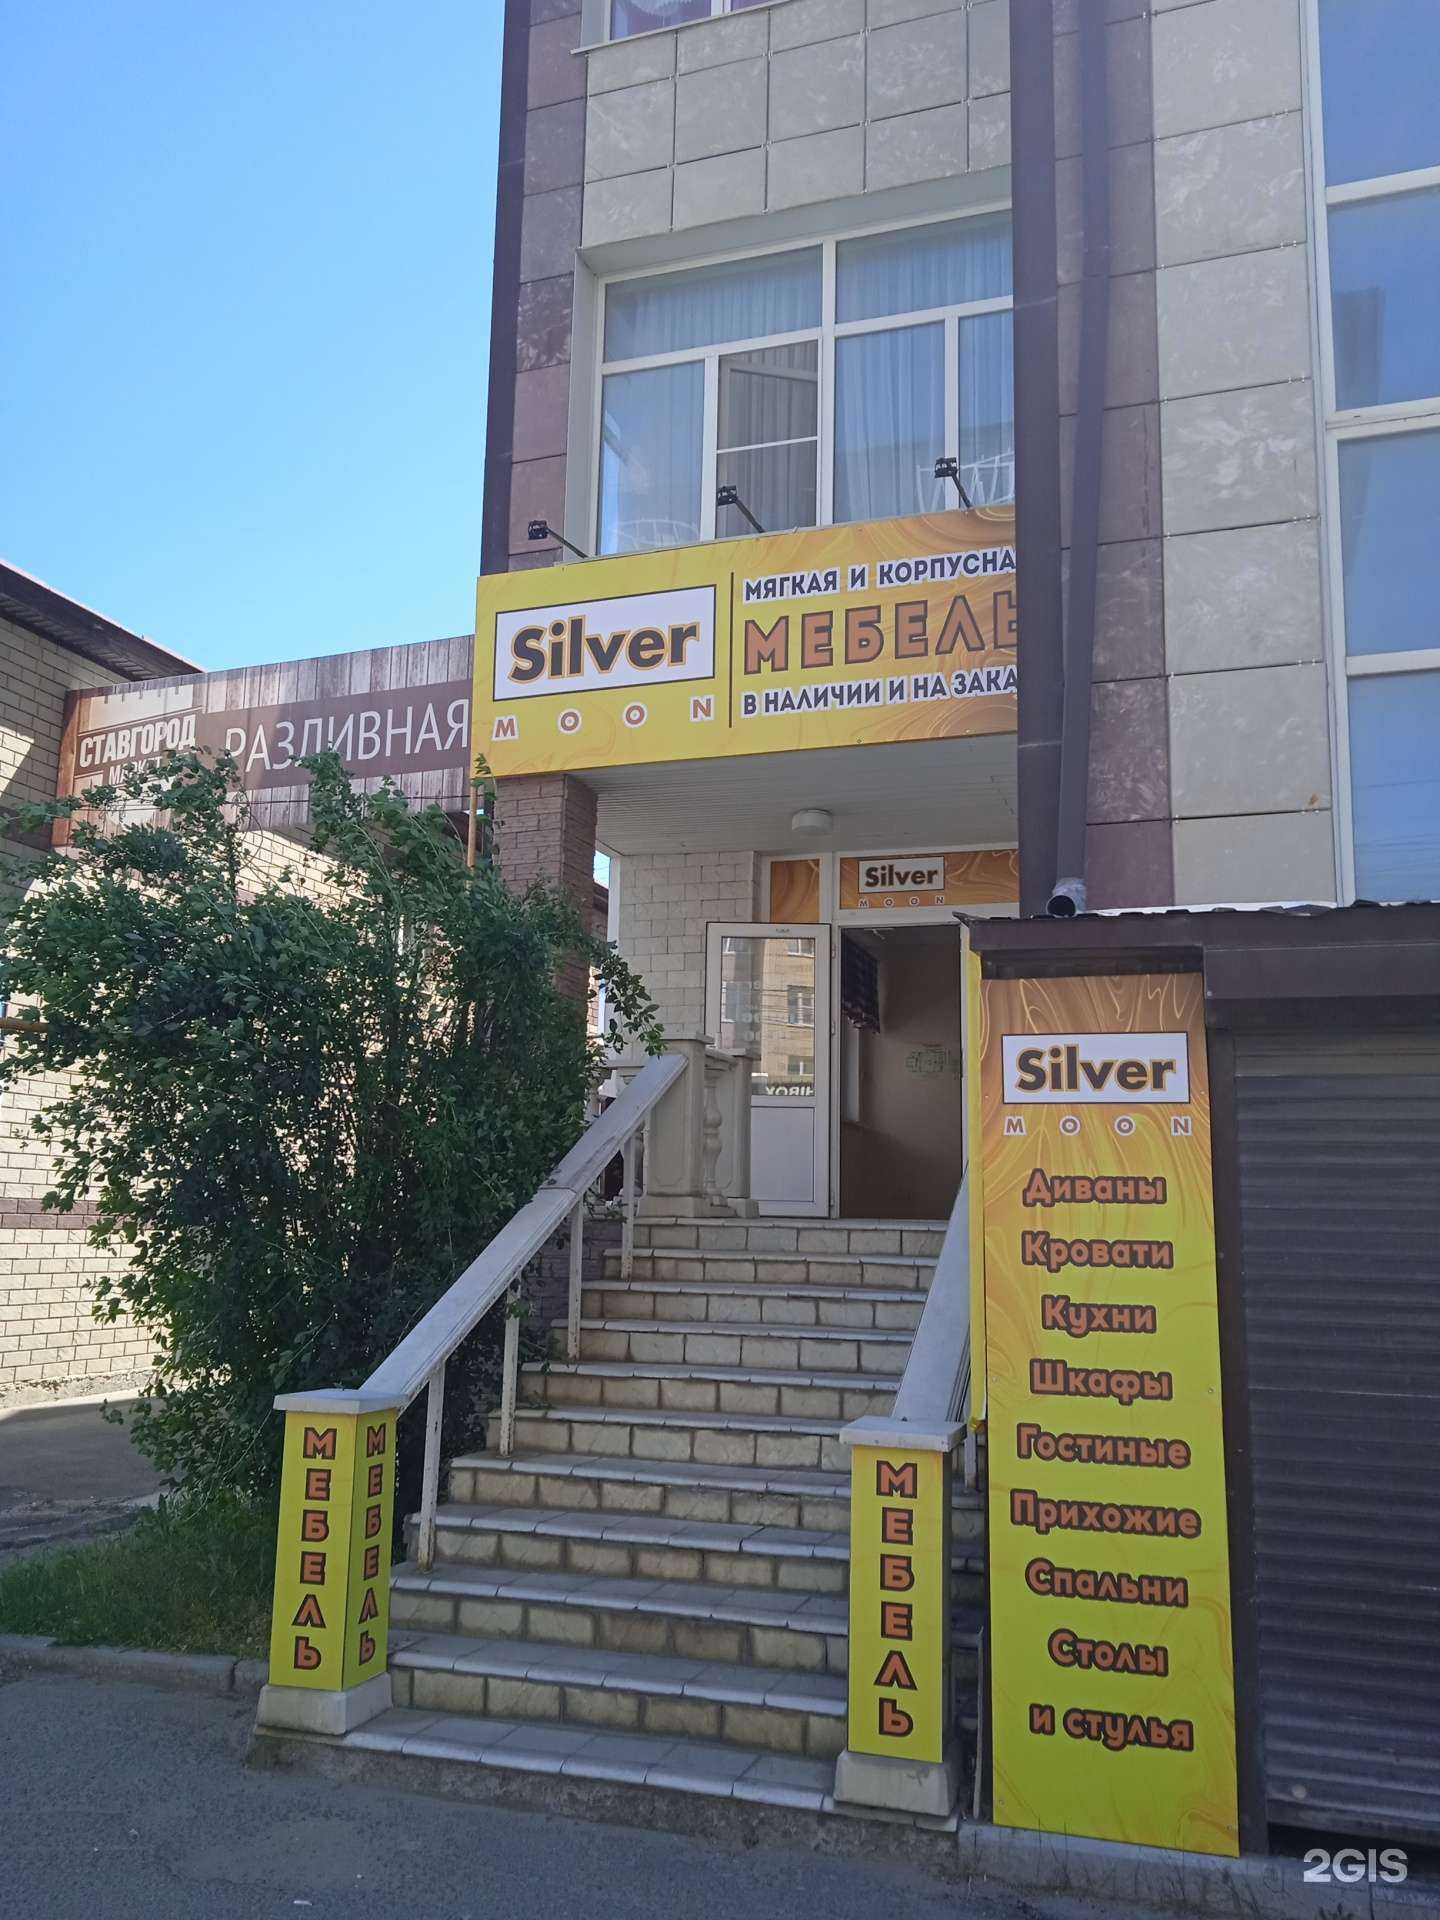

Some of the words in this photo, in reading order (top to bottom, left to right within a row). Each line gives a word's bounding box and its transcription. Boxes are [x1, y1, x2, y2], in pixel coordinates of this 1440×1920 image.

[745, 570, 838, 600] МЯГКАЯ
[850, 567, 866, 588] И
[508, 614, 700, 684] Silver
[494, 697, 713, 739] MOON
[743, 694, 757, 715] В
[765, 682, 881, 713] НАЛИЧИИ
[889, 680, 904, 701] И
[913, 677, 947, 699] НА
[79, 714, 196, 768] СТАВГОРОД
[224, 698, 470, 773] РАЗЛИВНАЯ
[864, 864, 938, 888] Silver
[859, 896, 944, 907] MOON
[1015, 1043, 1176, 1093] Silver
[1005, 1117, 1190, 1135] MOON
[1023, 1168, 1167, 1207] Диваны
[1021, 1230, 1174, 1273] Кровати
[1041, 1295, 1157, 1338] Кухни
[1030, 1358, 1173, 1405] Шкафы
[1017, 1422, 1191, 1469] Гостиные
[1010, 1488, 1201, 1539] Прихожие
[292, 1427, 338, 1671] МЕБЕЛЬ
[358, 1422, 386, 1666] МЕБЕЛЬ
[874, 1460, 918, 1738] МЕБЕЛЬ
[1025, 1557, 1188, 1608] Спальни
[1048, 1628, 1168, 1677] Столы
[1029, 1704, 1055, 1735] и
[1063, 1708, 1194, 1751] стулья
